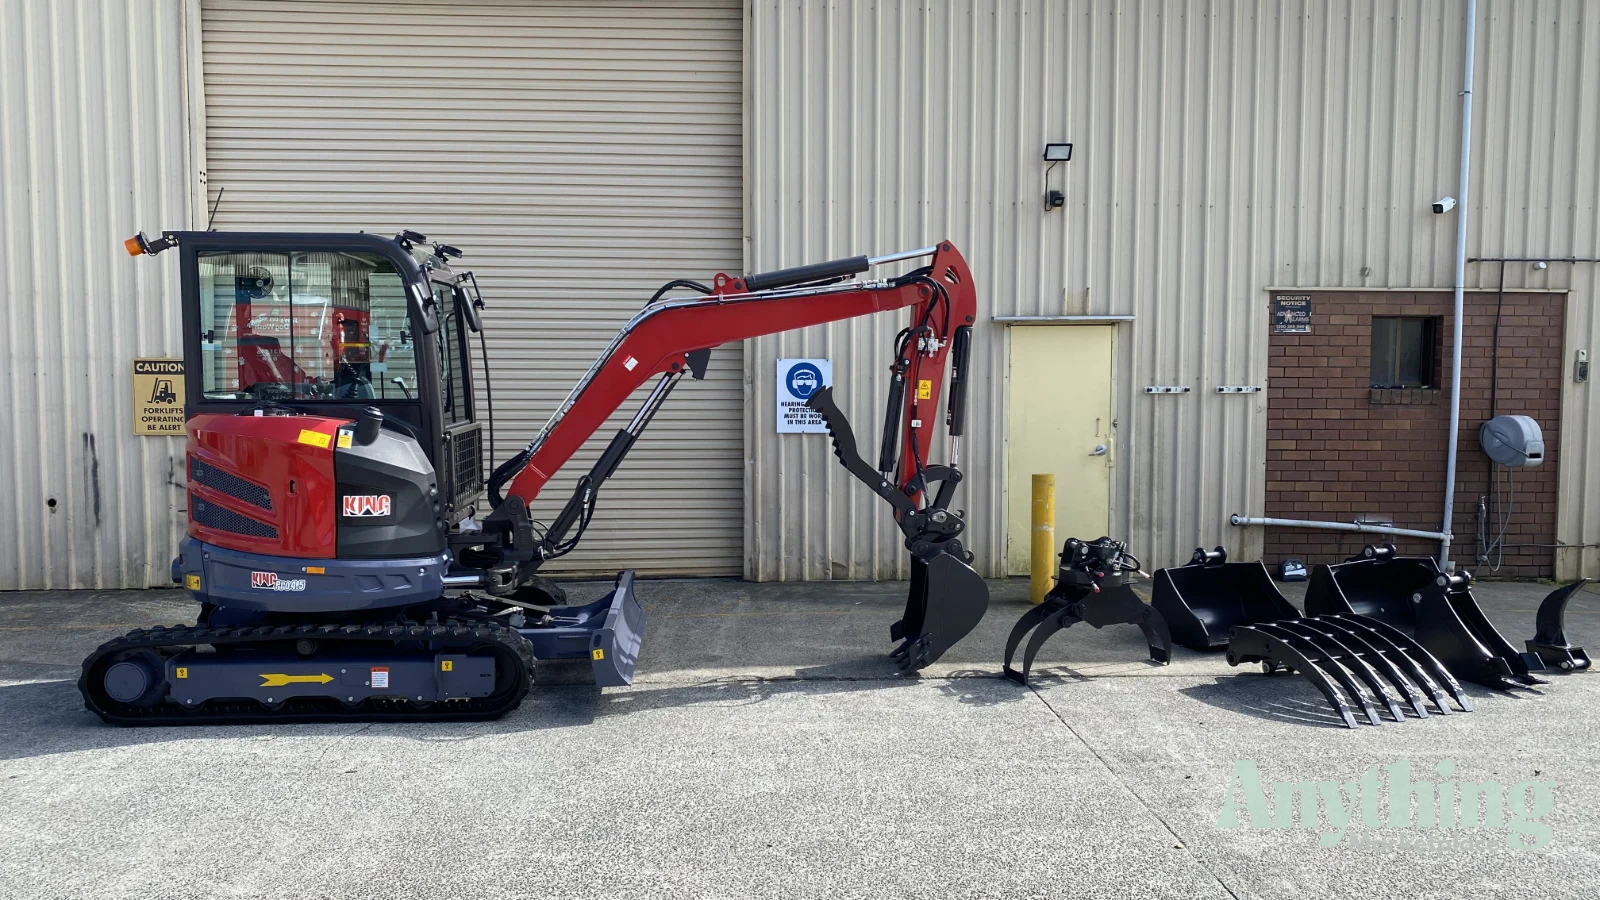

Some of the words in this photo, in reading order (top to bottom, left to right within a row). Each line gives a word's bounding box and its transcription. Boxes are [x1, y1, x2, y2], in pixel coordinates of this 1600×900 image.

[136, 363, 184, 372] CAUTION
[343, 495, 391, 517] KING
[252, 571, 277, 589] KING
